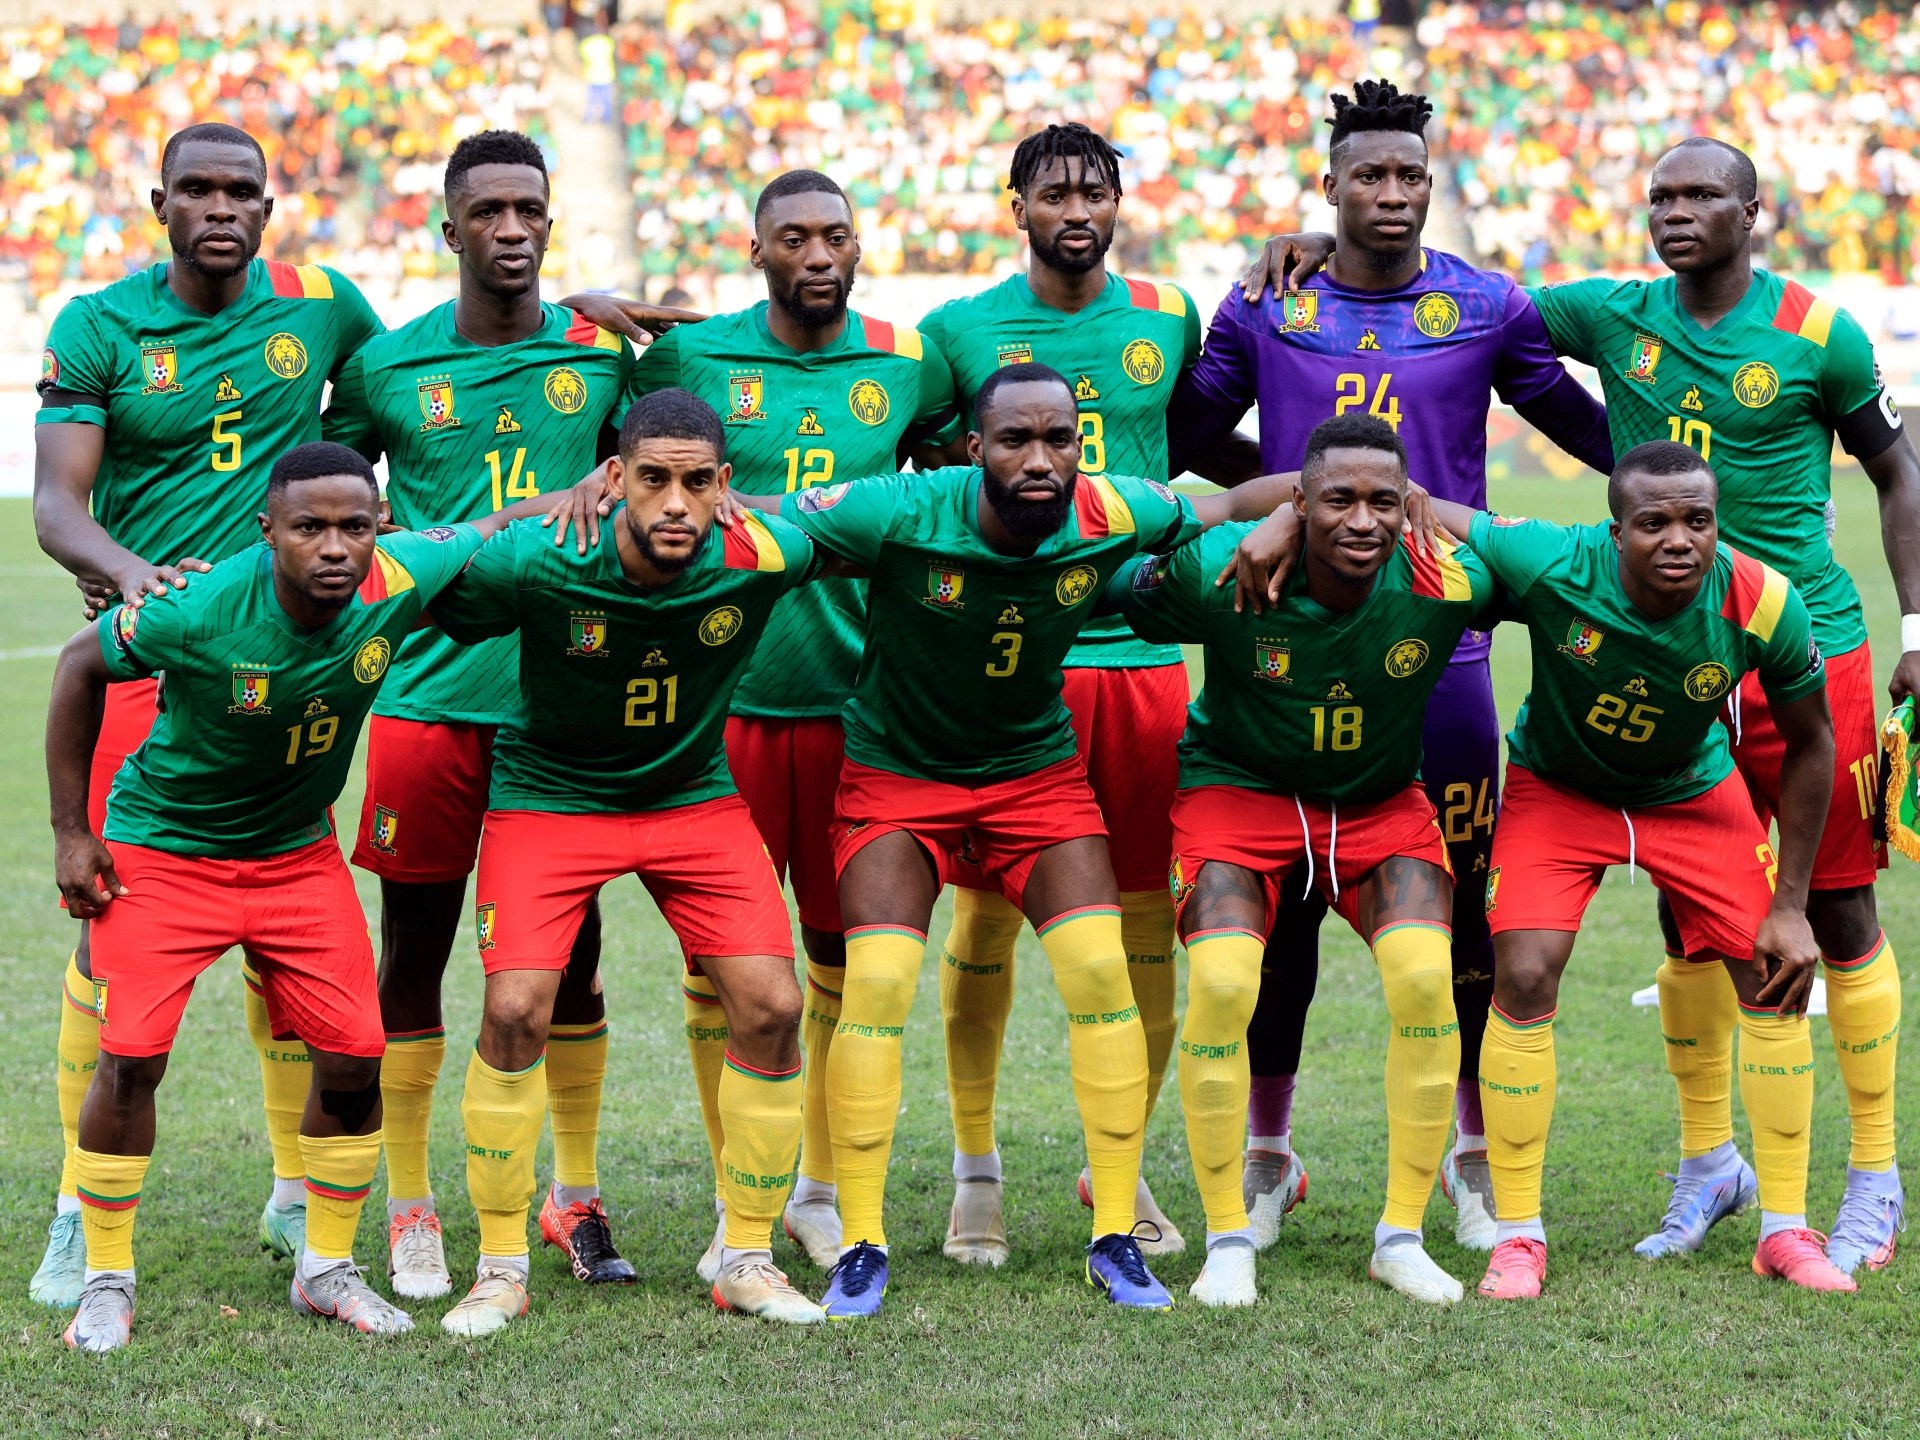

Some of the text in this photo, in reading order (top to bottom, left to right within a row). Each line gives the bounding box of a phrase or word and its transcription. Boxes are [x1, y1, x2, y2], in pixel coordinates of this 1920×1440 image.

[1336, 373, 1402, 432] 24
[211, 410, 243, 472] 5
[1077, 410, 1106, 473] 8
[1668, 416, 1712, 463] 10
[485, 447, 540, 512] 14
[783, 447, 835, 494] 12
[985, 631, 1023, 678] 3
[624, 674, 678, 727] 21
[1585, 693, 1665, 743] 25
[286, 716, 339, 765] 19
[1309, 706, 1363, 752] 18
[1444, 777, 1495, 843] 24
[1849, 753, 1878, 821] 10
[838, 1023, 848, 1034] LE
[851, 1023, 873, 1038] COQ
[1076, 1014, 1098, 1025] COQ
[1400, 1026, 1411, 1038] LE
[1413, 1027, 1438, 1038] COQ
[264, 1048, 278, 1062] LE
[1191, 1041, 1239, 1059] SPORTIF
[1743, 1062, 1756, 1073] LE
[1760, 1065, 1789, 1075] COQ
[1852, 1038, 1878, 1054] COQ
[1488, 1081, 1541, 1096] SPORTIF
[736, 1171, 758, 1188] COQ
